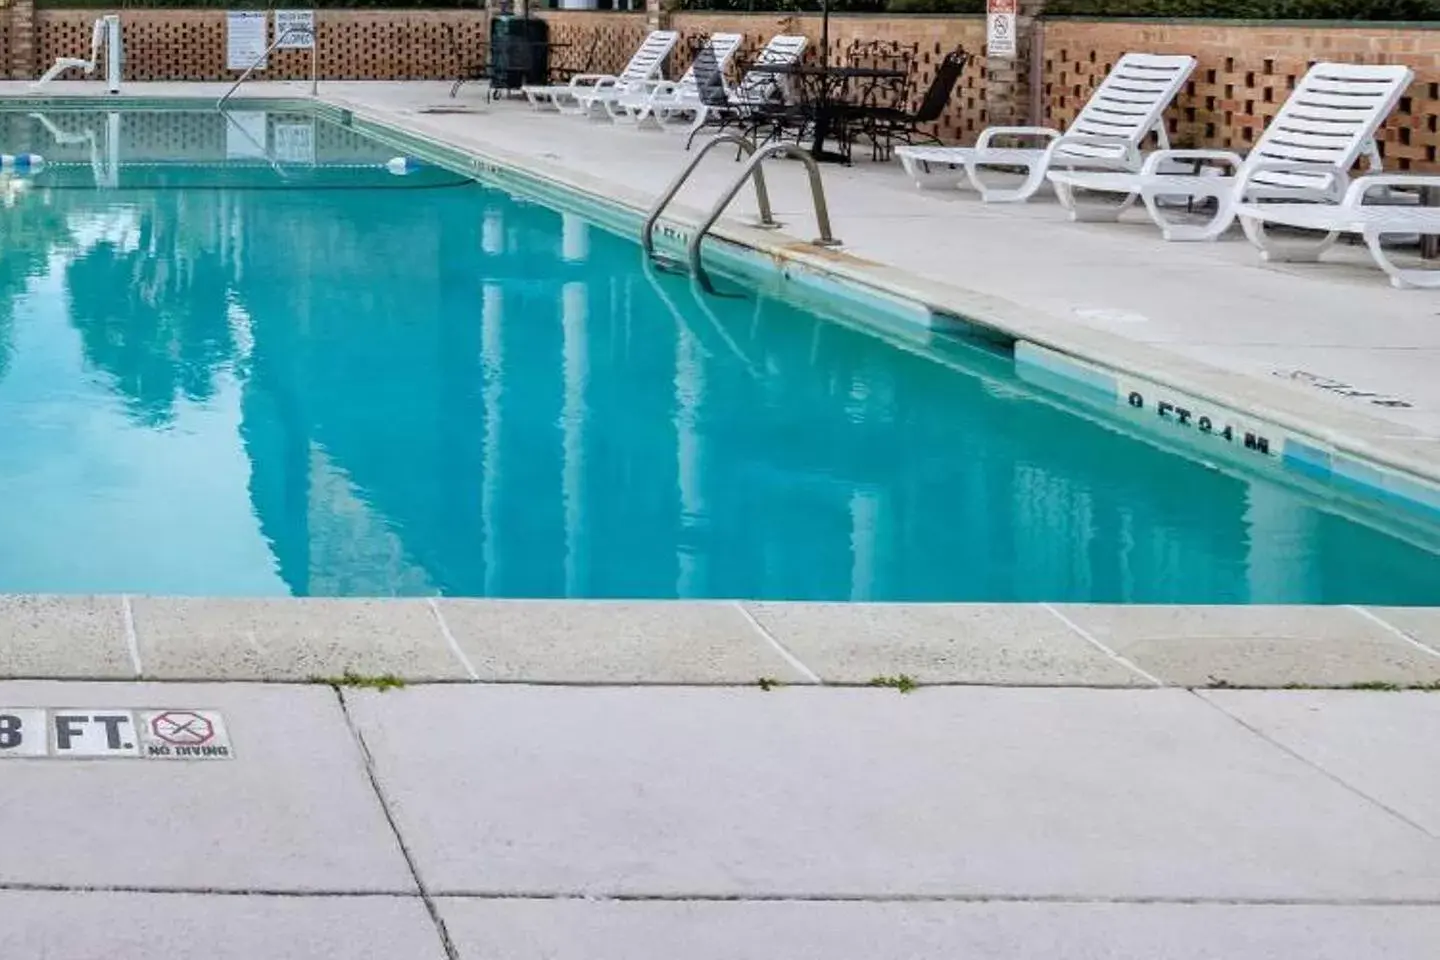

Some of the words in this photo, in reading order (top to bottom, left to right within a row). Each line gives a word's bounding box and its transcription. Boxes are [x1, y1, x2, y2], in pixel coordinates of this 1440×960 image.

[54, 715, 134, 749] FT.
[148, 745, 170, 756] NO
[175, 744, 229, 757] DIVING
